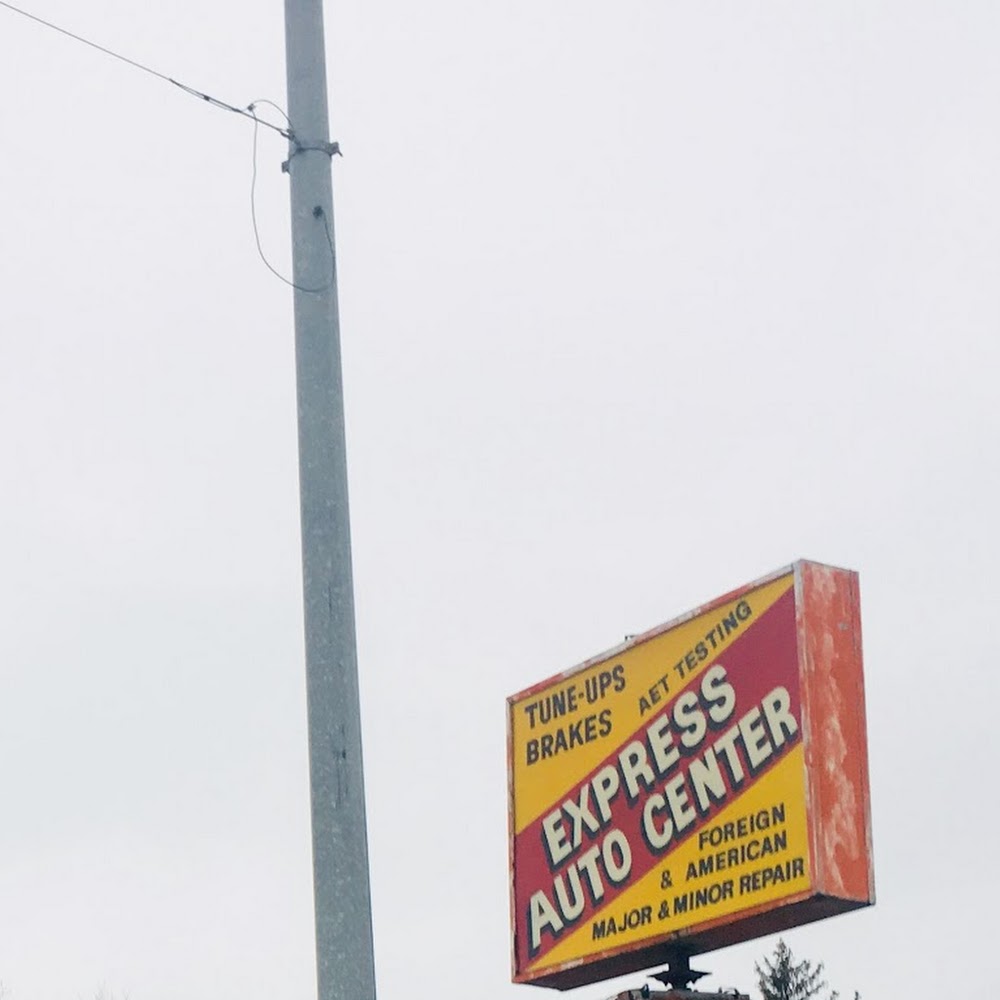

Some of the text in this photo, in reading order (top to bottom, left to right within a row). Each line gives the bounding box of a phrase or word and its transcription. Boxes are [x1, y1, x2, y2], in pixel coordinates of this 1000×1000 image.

[638, 600, 753, 717] AET TESTING
[525, 664, 626, 729] TUNE-UPS
[526, 709, 613, 766] BRAKES
[542, 664, 737, 869] EXPRESS
[527, 685, 800, 958] AUTO CENTER
[698, 803, 786, 850] FOREIGN
[660, 831, 788, 890] & AMERICAN
[592, 857, 805, 942] MAJOR & MINOR REPAIR
